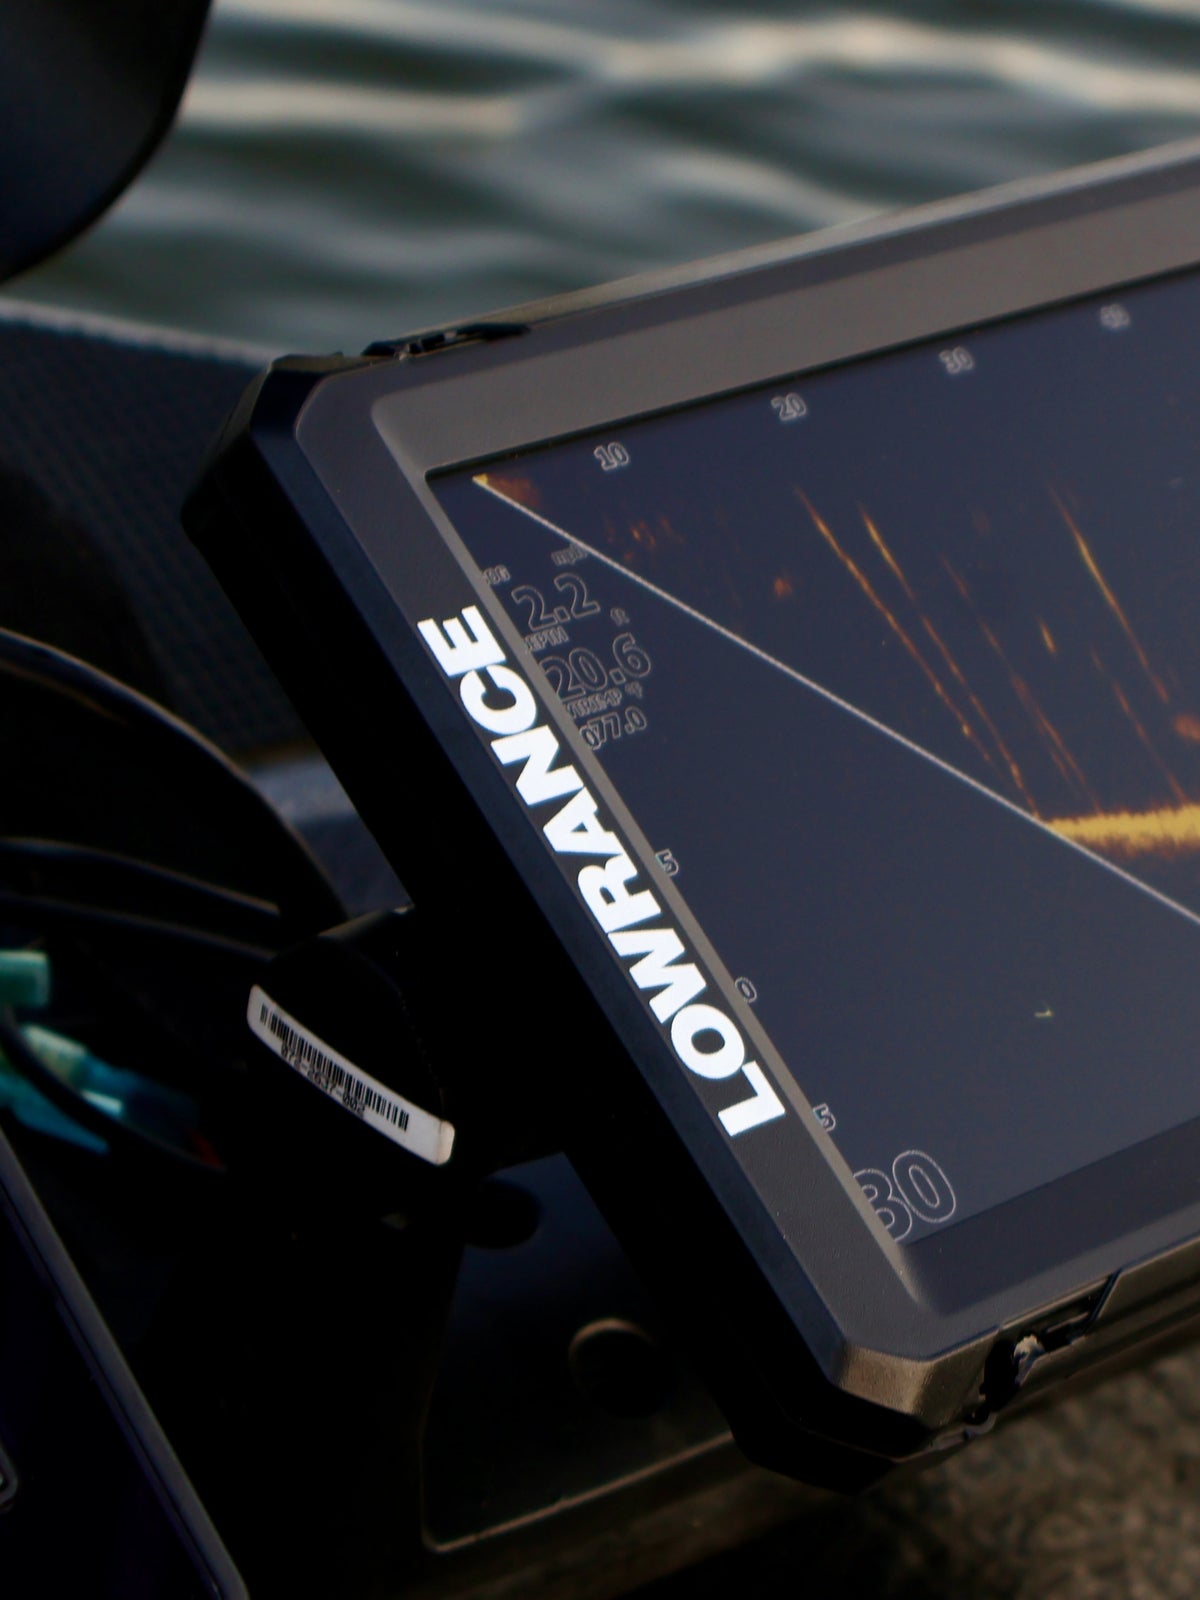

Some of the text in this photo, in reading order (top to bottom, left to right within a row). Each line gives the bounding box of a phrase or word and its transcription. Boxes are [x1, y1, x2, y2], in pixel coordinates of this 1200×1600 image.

[770, 393, 807, 421] 20
[593, 442, 629, 470] 10
[511, 573, 600, 631] 2.2
[538, 632, 652, 700] 20.6
[417, 605, 785, 1137] LOWRANCE
